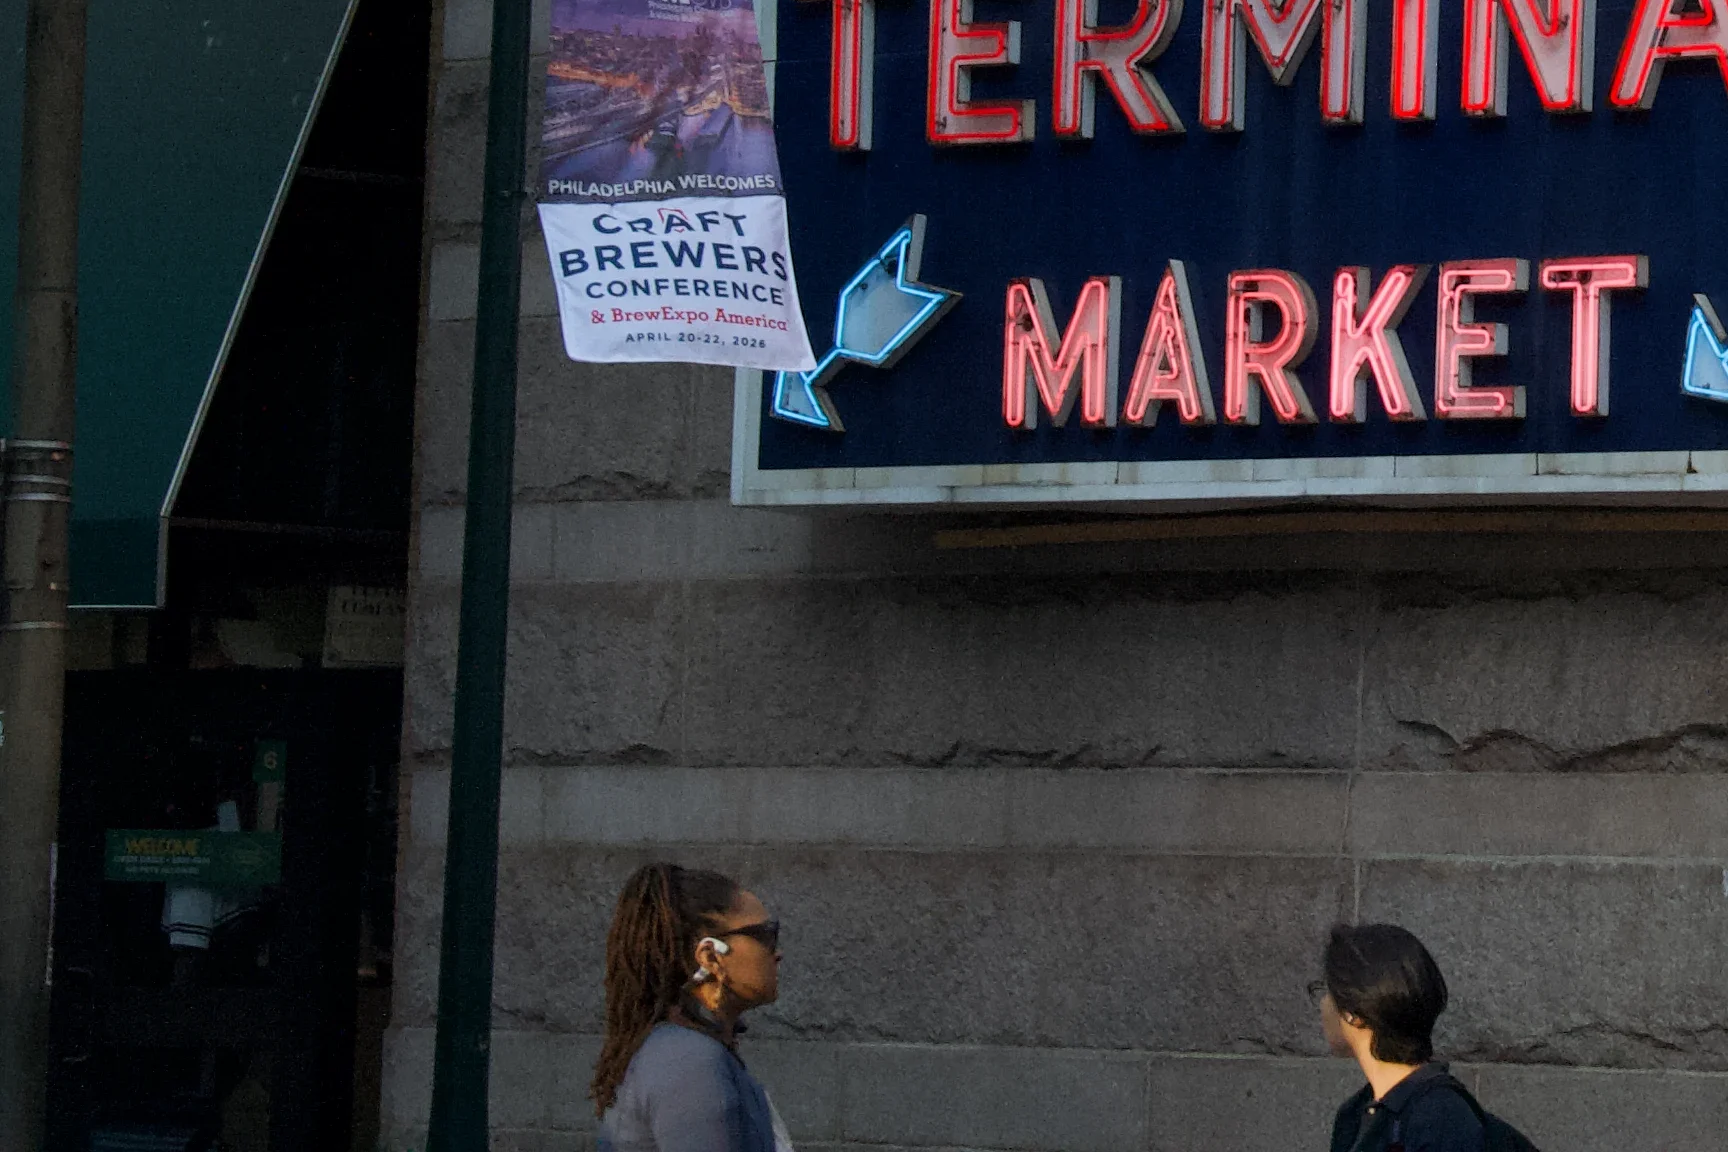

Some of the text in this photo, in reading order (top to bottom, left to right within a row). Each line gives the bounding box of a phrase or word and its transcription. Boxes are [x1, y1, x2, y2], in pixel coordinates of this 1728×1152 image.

[548, 173, 776, 197] PHILADELPHIA WELCOMES
[592, 209, 747, 237] CRAFT
[559, 240, 788, 281] BREWERS
[586, 278, 784, 306] CONFERENCE
[591, 306, 788, 331] & BrewExpo America
[625, 332, 766, 348] APRIL 20-22, 2026
[1002, 254, 1649, 430] MARKET
[263, 750, 278, 770] 6
